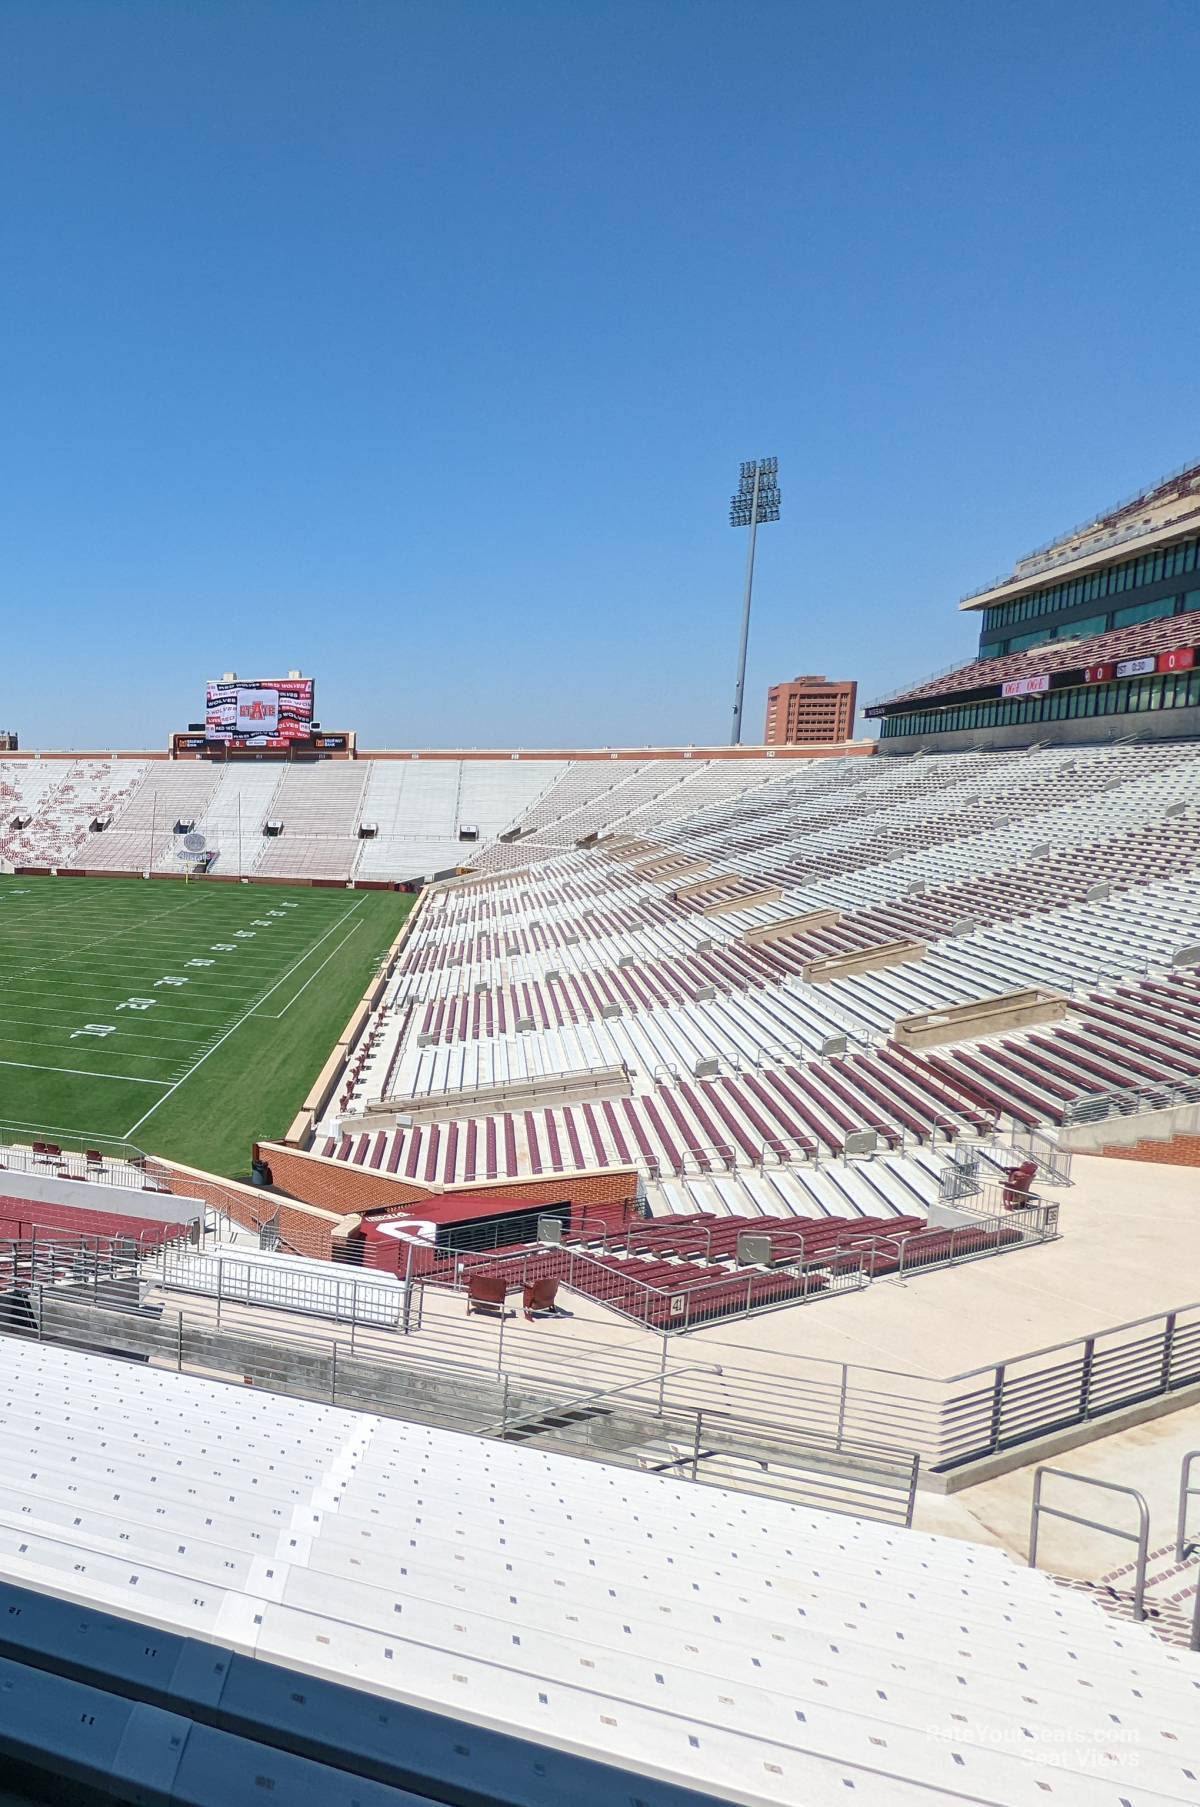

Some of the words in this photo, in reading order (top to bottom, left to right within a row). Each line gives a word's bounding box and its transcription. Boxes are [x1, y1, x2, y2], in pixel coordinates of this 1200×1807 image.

[1169, 655, 1175, 667] 0
[115, 997, 157, 1010] 20
[70, 1024, 116, 1038] 10
[673, 1299, 682, 1311] 41
